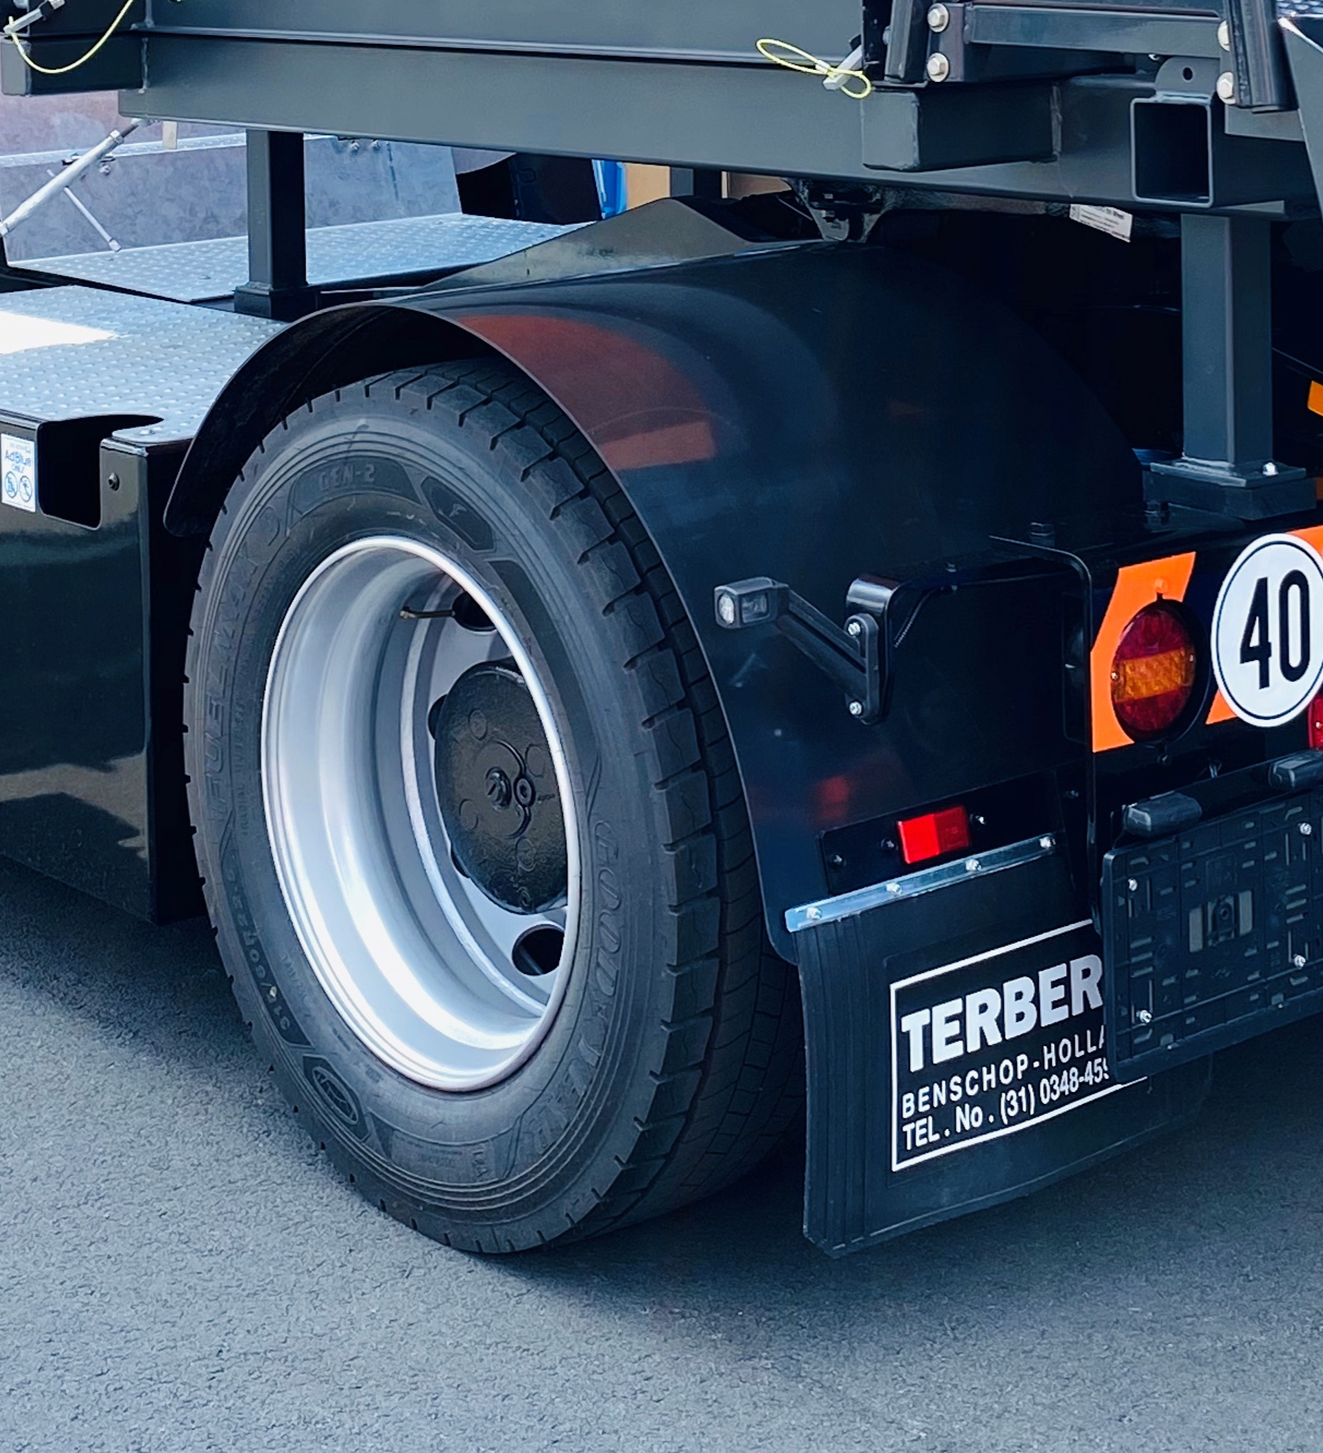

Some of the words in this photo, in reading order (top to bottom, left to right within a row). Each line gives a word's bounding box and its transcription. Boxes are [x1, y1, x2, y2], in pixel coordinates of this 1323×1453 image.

[1238, 569, 1312, 689] 40
[900, 953, 1104, 1073] TERBER
[1000, 1082, 1036, 1126] (31)
